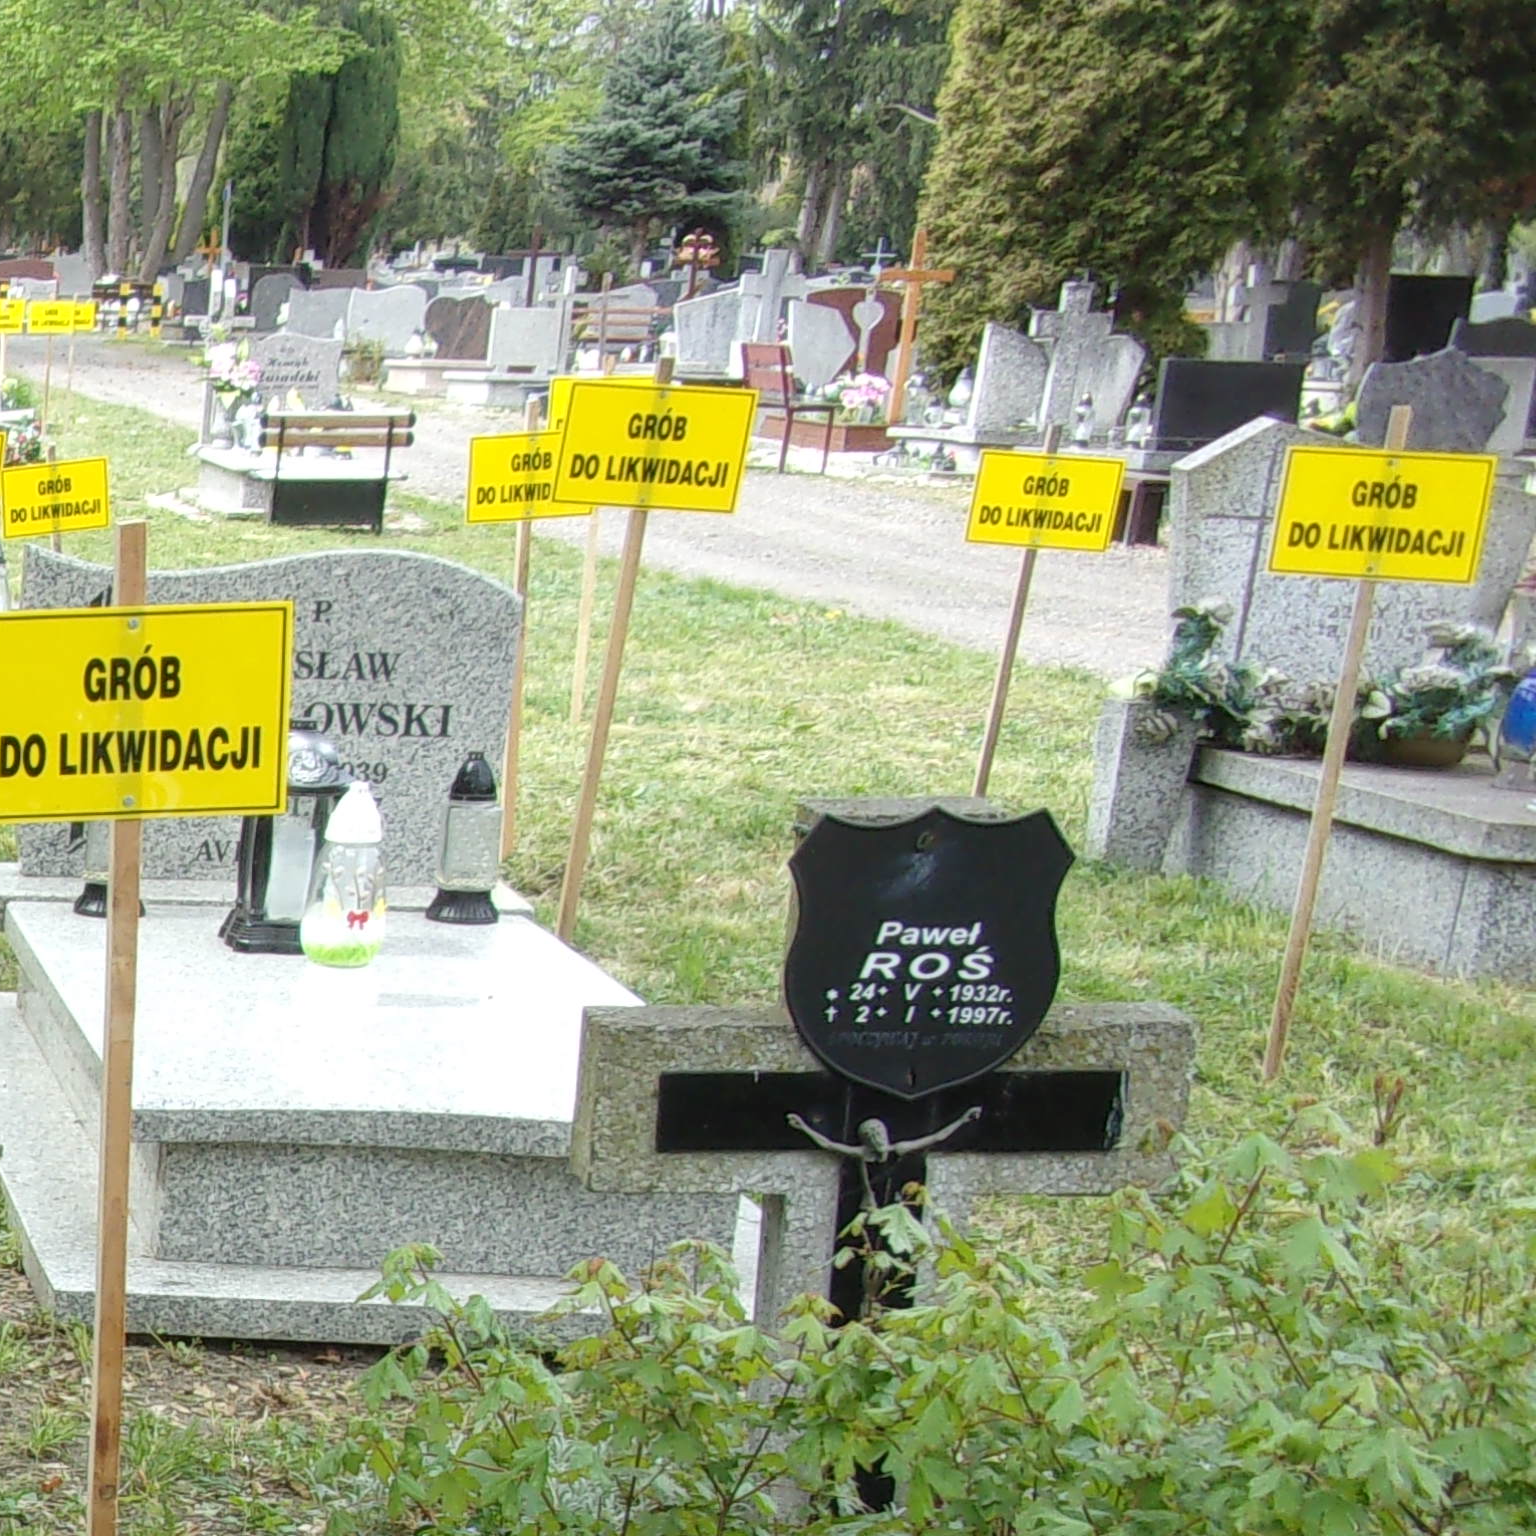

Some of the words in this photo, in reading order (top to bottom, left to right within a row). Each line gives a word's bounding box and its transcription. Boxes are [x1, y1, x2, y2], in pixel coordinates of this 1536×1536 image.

[628, 408, 688, 442] GRÓB
[511, 447, 552, 473] GRÓB
[569, 454, 599, 480] DO
[605, 455, 729, 489] LIKWIDACJI
[38, 476, 72, 496] GRÓB
[477, 486, 496, 505] DO
[500, 483, 551, 503] LIKWID
[1023, 474, 1070, 498] GRÓB
[1351, 475, 1418, 510] GRÓB
[10, 508, 28, 523] DO
[31, 499, 101, 522] LIKWIDACJI
[978, 504, 1002, 526] DO
[1006, 506, 1101, 534] LIKWIDACJI
[1288, 522, 1317, 549] DO
[1329, 527, 1465, 559] LIKWIDACJI
[83, 644, 182, 703] GRÓB
[292, 650, 402, 682] SŁAW
[303, 701, 454, 738] OWSKI
[0, 733, 46, 779] DO
[59, 725, 262, 776] LIKWIDACJI
[192, 839, 241, 864] AV
[876, 920, 983, 946] Paweł
[859, 946, 995, 980] ROŚ
[848, 983, 876, 1001] 24
[904, 984, 921, 1001] V
[948, 984, 1014, 1003] 1932r.
[854, 1006, 869, 1023] 2
[947, 1006, 1014, 1026] 1997r.
